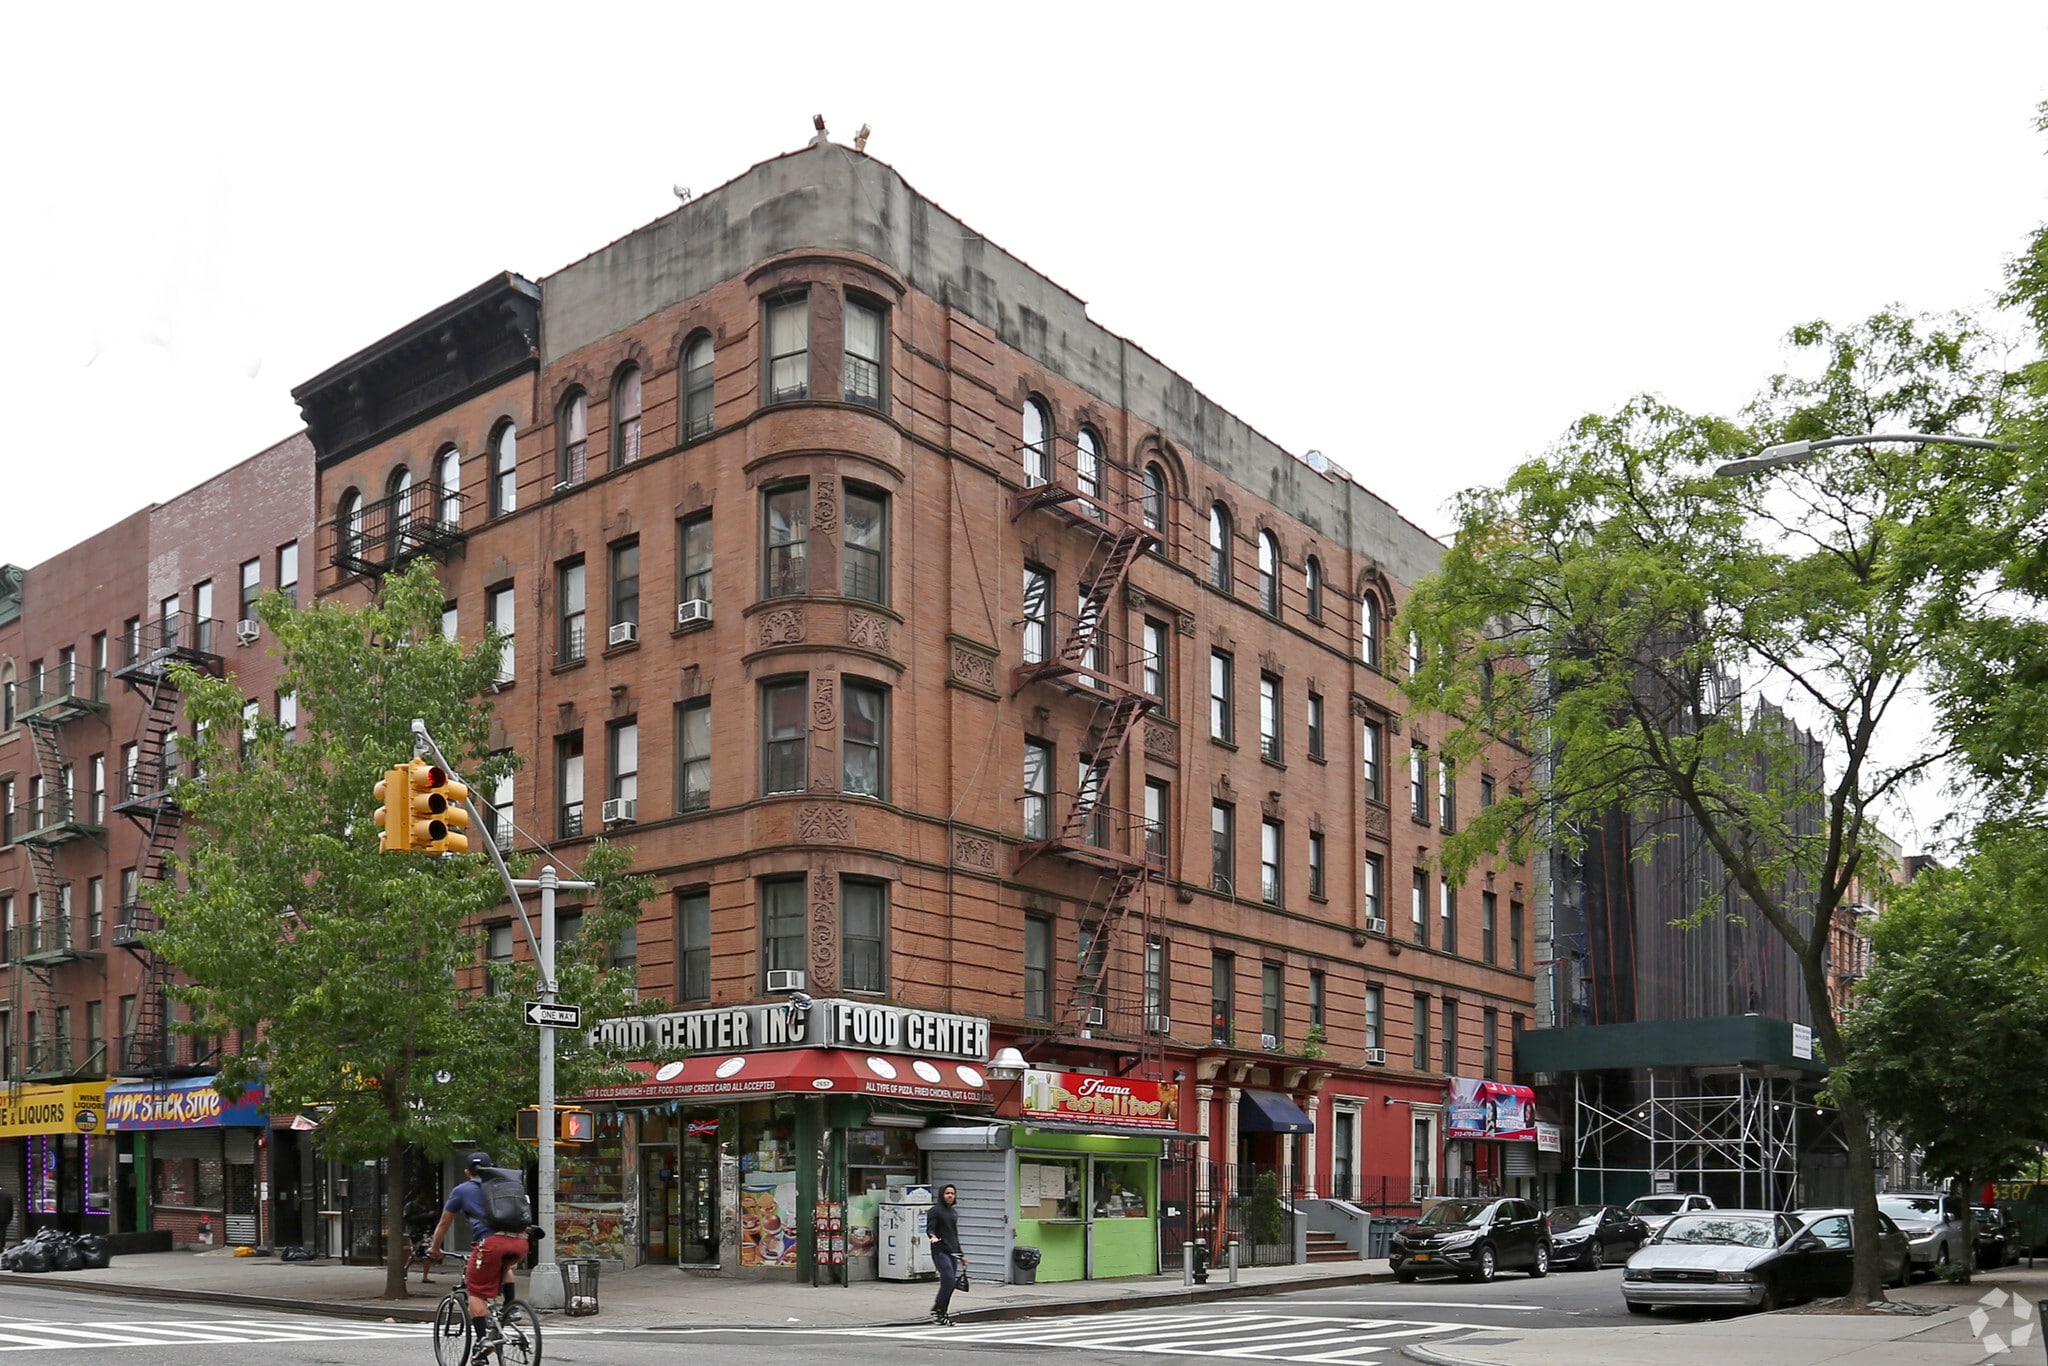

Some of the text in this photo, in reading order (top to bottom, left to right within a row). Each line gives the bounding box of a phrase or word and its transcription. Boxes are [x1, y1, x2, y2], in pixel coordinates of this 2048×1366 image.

[541, 1010, 574, 1021] ONE WAY
[588, 1007, 805, 1051] FOOD CENTER INC
[838, 1004, 988, 1057] FOOD CENTER
[600, 1088, 615, 1097] COLD
[615, 1087, 643, 1096] SANDWICH
[658, 1086, 674, 1095] FOOD
[674, 1085, 693, 1094] STAMP
[694, 1083, 715, 1093] CREDIT
[715, 1082, 732, 1092] CARD
[732, 1082, 743, 1091] ALL
[744, 1080, 776, 1090] ACCEPTED
[865, 1081, 877, 1091] ALL
[876, 1082, 890, 1093] TYPE
[890, 1084, 898, 1094] OF
[914, 1087, 929, 1097] FRIED
[952, 1090, 963, 1099] HOT
[968, 1092, 980, 1101] COLD
[1078, 1078, 1131, 1096] Juana
[1050, 1087, 1161, 1117] Pastelitos
[10, 1112, 15, 1125] &
[18, 1103, 64, 1125] LIQUORS
[887, 1218, 897, 1266] ICE
